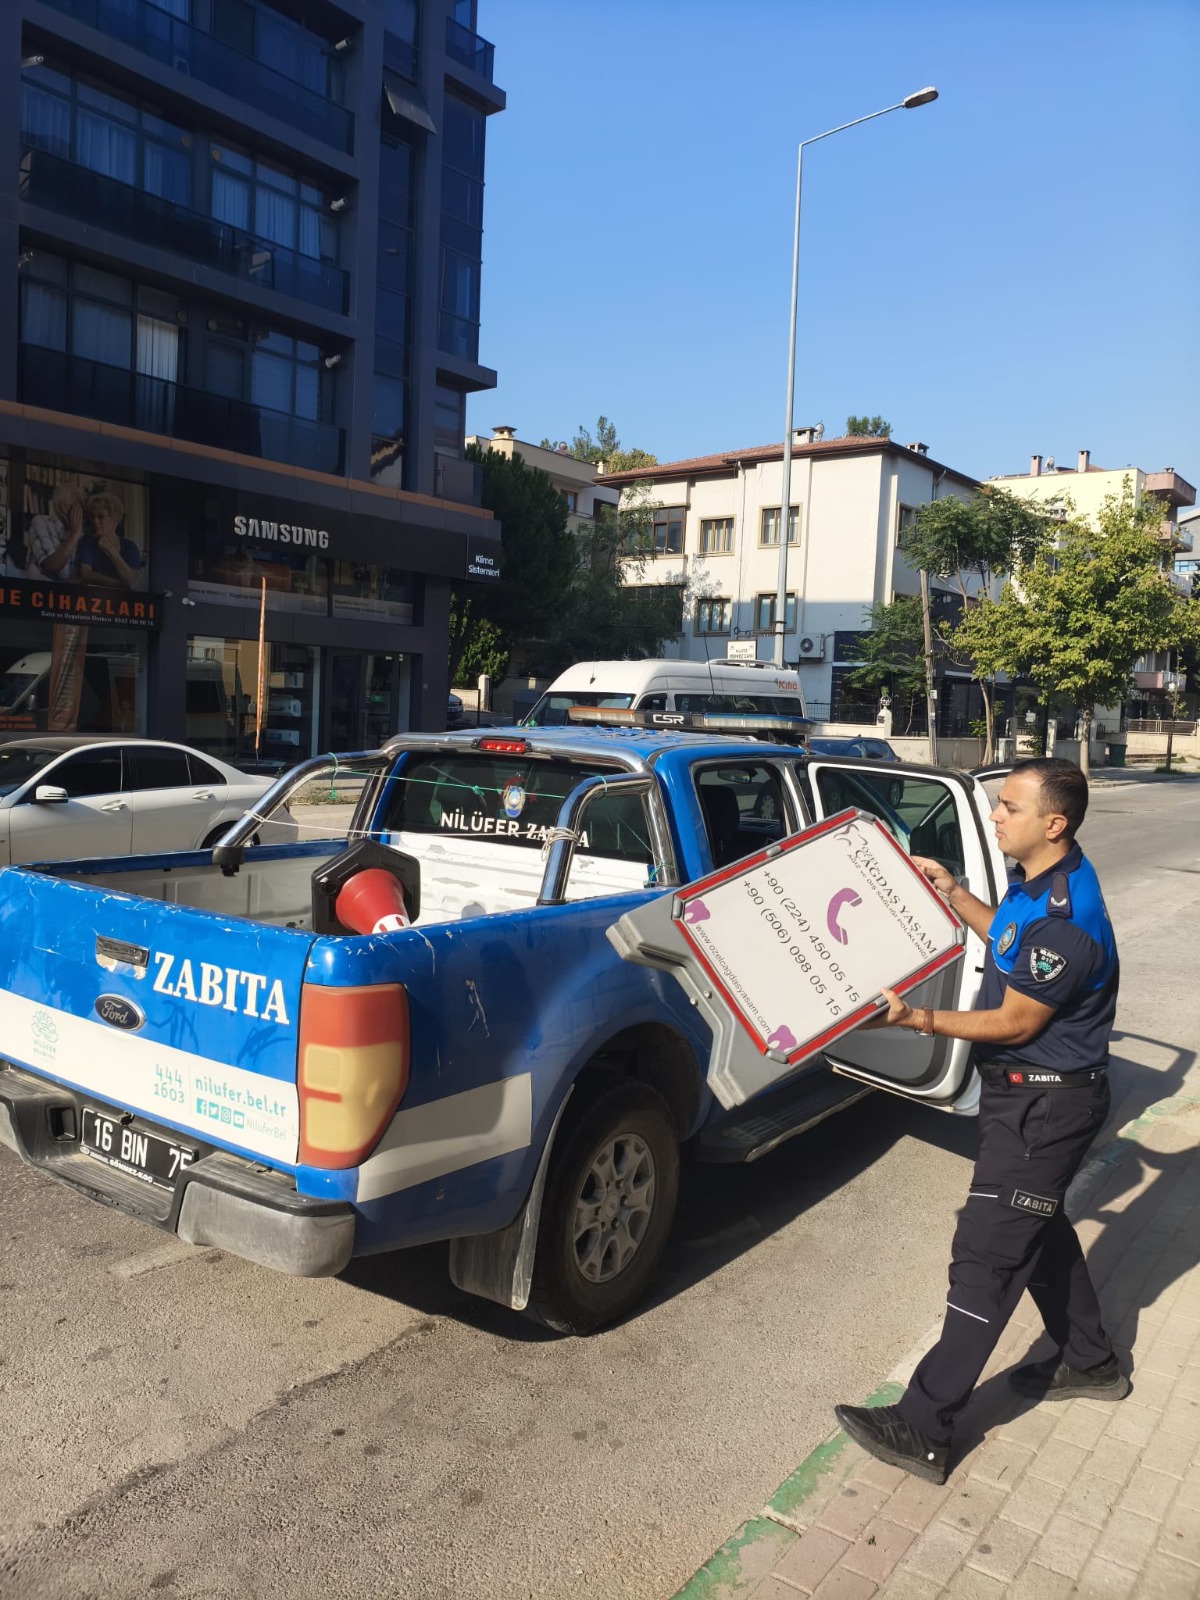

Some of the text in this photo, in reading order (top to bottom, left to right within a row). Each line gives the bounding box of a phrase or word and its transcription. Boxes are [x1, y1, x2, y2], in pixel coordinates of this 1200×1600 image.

[234, 515, 329, 549] SAMSUNG
[468, 565, 500, 577] Sistemleri
[475, 555, 494, 566] Klima
[31, 590, 155, 618] CİHAZLARI
[652, 713, 685, 725] CSR
[440, 808, 519, 838] NİLÜFER
[764, 871, 860, 1002] +90 (224) 450 05 15
[899, 905, 937, 954] YAŞAM
[744, 881, 841, 1015] +90 (506) 098 05 15
[153, 951, 290, 1025] ZABITA
[101, 1000, 129, 1024] Ford
[156, 1063, 182, 1088] 444
[1028, 1074, 1062, 1082] ZABITA
[153, 1082, 185, 1104] 1603
[195, 1076, 286, 1117] nilufer.bel.tr
[94, 1118, 113, 1152] 16
[121, 1129, 148, 1168] BIN
[1017, 1194, 1052, 1213] ZABITA
